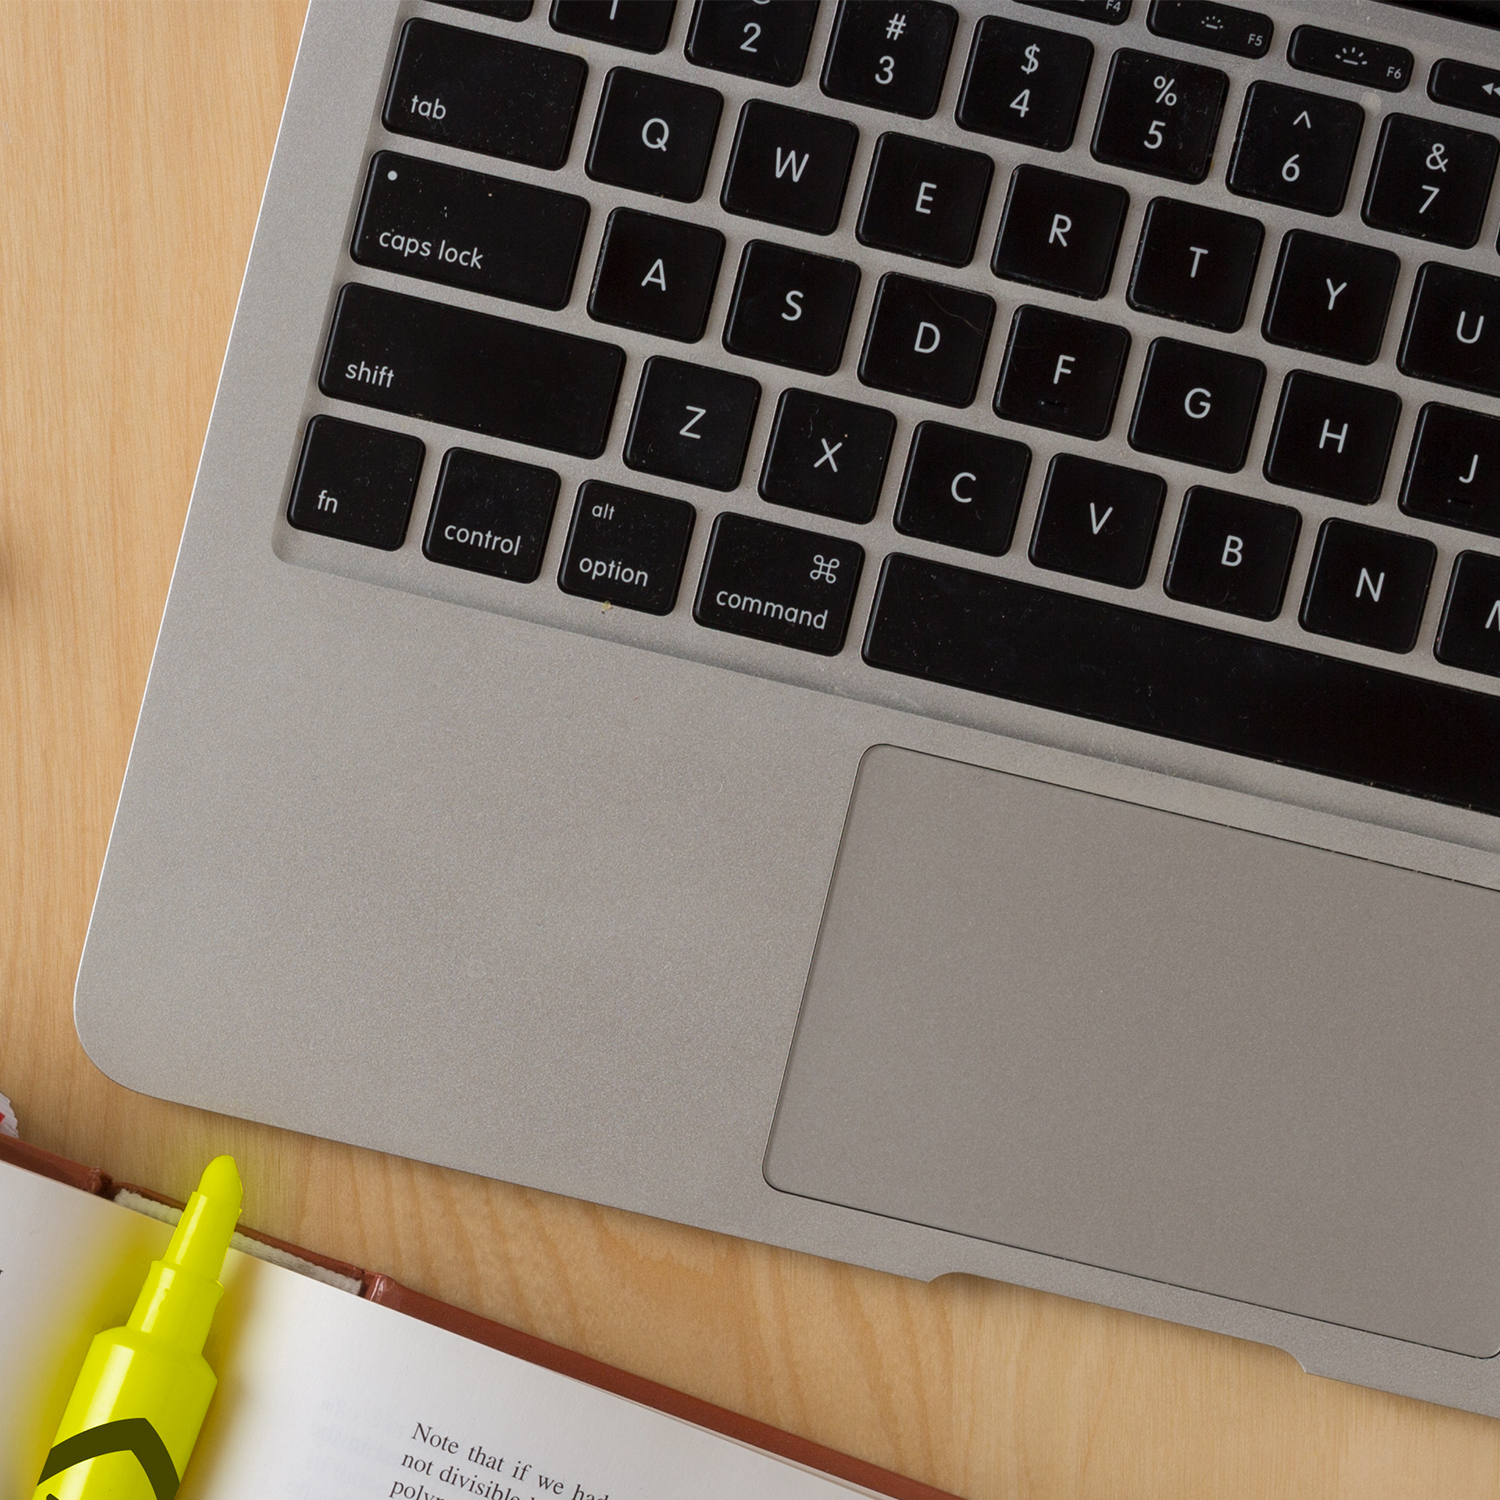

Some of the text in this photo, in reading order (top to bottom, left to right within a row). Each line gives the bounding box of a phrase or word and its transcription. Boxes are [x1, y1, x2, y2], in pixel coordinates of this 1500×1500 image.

[740, 22, 761, 53] 2
[885, 13, 907, 41] #
[1248, 33, 1262, 46] F5
[875, 55, 895, 85] 3
[1020, 43, 1041, 75] $
[1387, 66, 1401, 79] F6
[1009, 88, 1030, 118] 4
[1153, 75, 1177, 106] %
[410, 95, 447, 120] tab
[641, 117, 670, 152] Q
[1143, 120, 1166, 149] 5
[775, 146, 810, 183] W
[1281, 154, 1300, 182] 6
[1425, 143, 1449, 173] &
[915, 181, 937, 214] E
[1419, 185, 1440, 214] 7
[1048, 213, 1072, 247] R
[378, 230, 484, 269] caps lock
[1189, 246, 1209, 278] T
[641, 258, 667, 292] A
[781, 290, 804, 321] S
[1326, 278, 1347, 311] Y
[914, 321, 941, 354] D
[1456, 311, 1484, 344] U
[345, 360, 395, 388] shift
[1053, 354, 1076, 385] F
[1184, 387, 1211, 419] G
[679, 405, 707, 439] Z
[1318, 418, 1348, 454] H
[813, 438, 843, 473] X
[1458, 454, 1479, 484] J
[317, 489, 338, 514] fn
[951, 472, 977, 503] C
[591, 502, 616, 521] alt
[1089, 502, 1113, 535] V
[444, 523, 521, 556] control
[1221, 535, 1243, 567] B
[579, 557, 649, 588] option
[1355, 567, 1385, 602] N
[715, 587, 829, 630] command
[410, 1421, 460, 1455] Note
[467, 1445, 506, 1473] that
[511, 1460, 533, 1482] if
[538, 1474, 565, 1495] we
